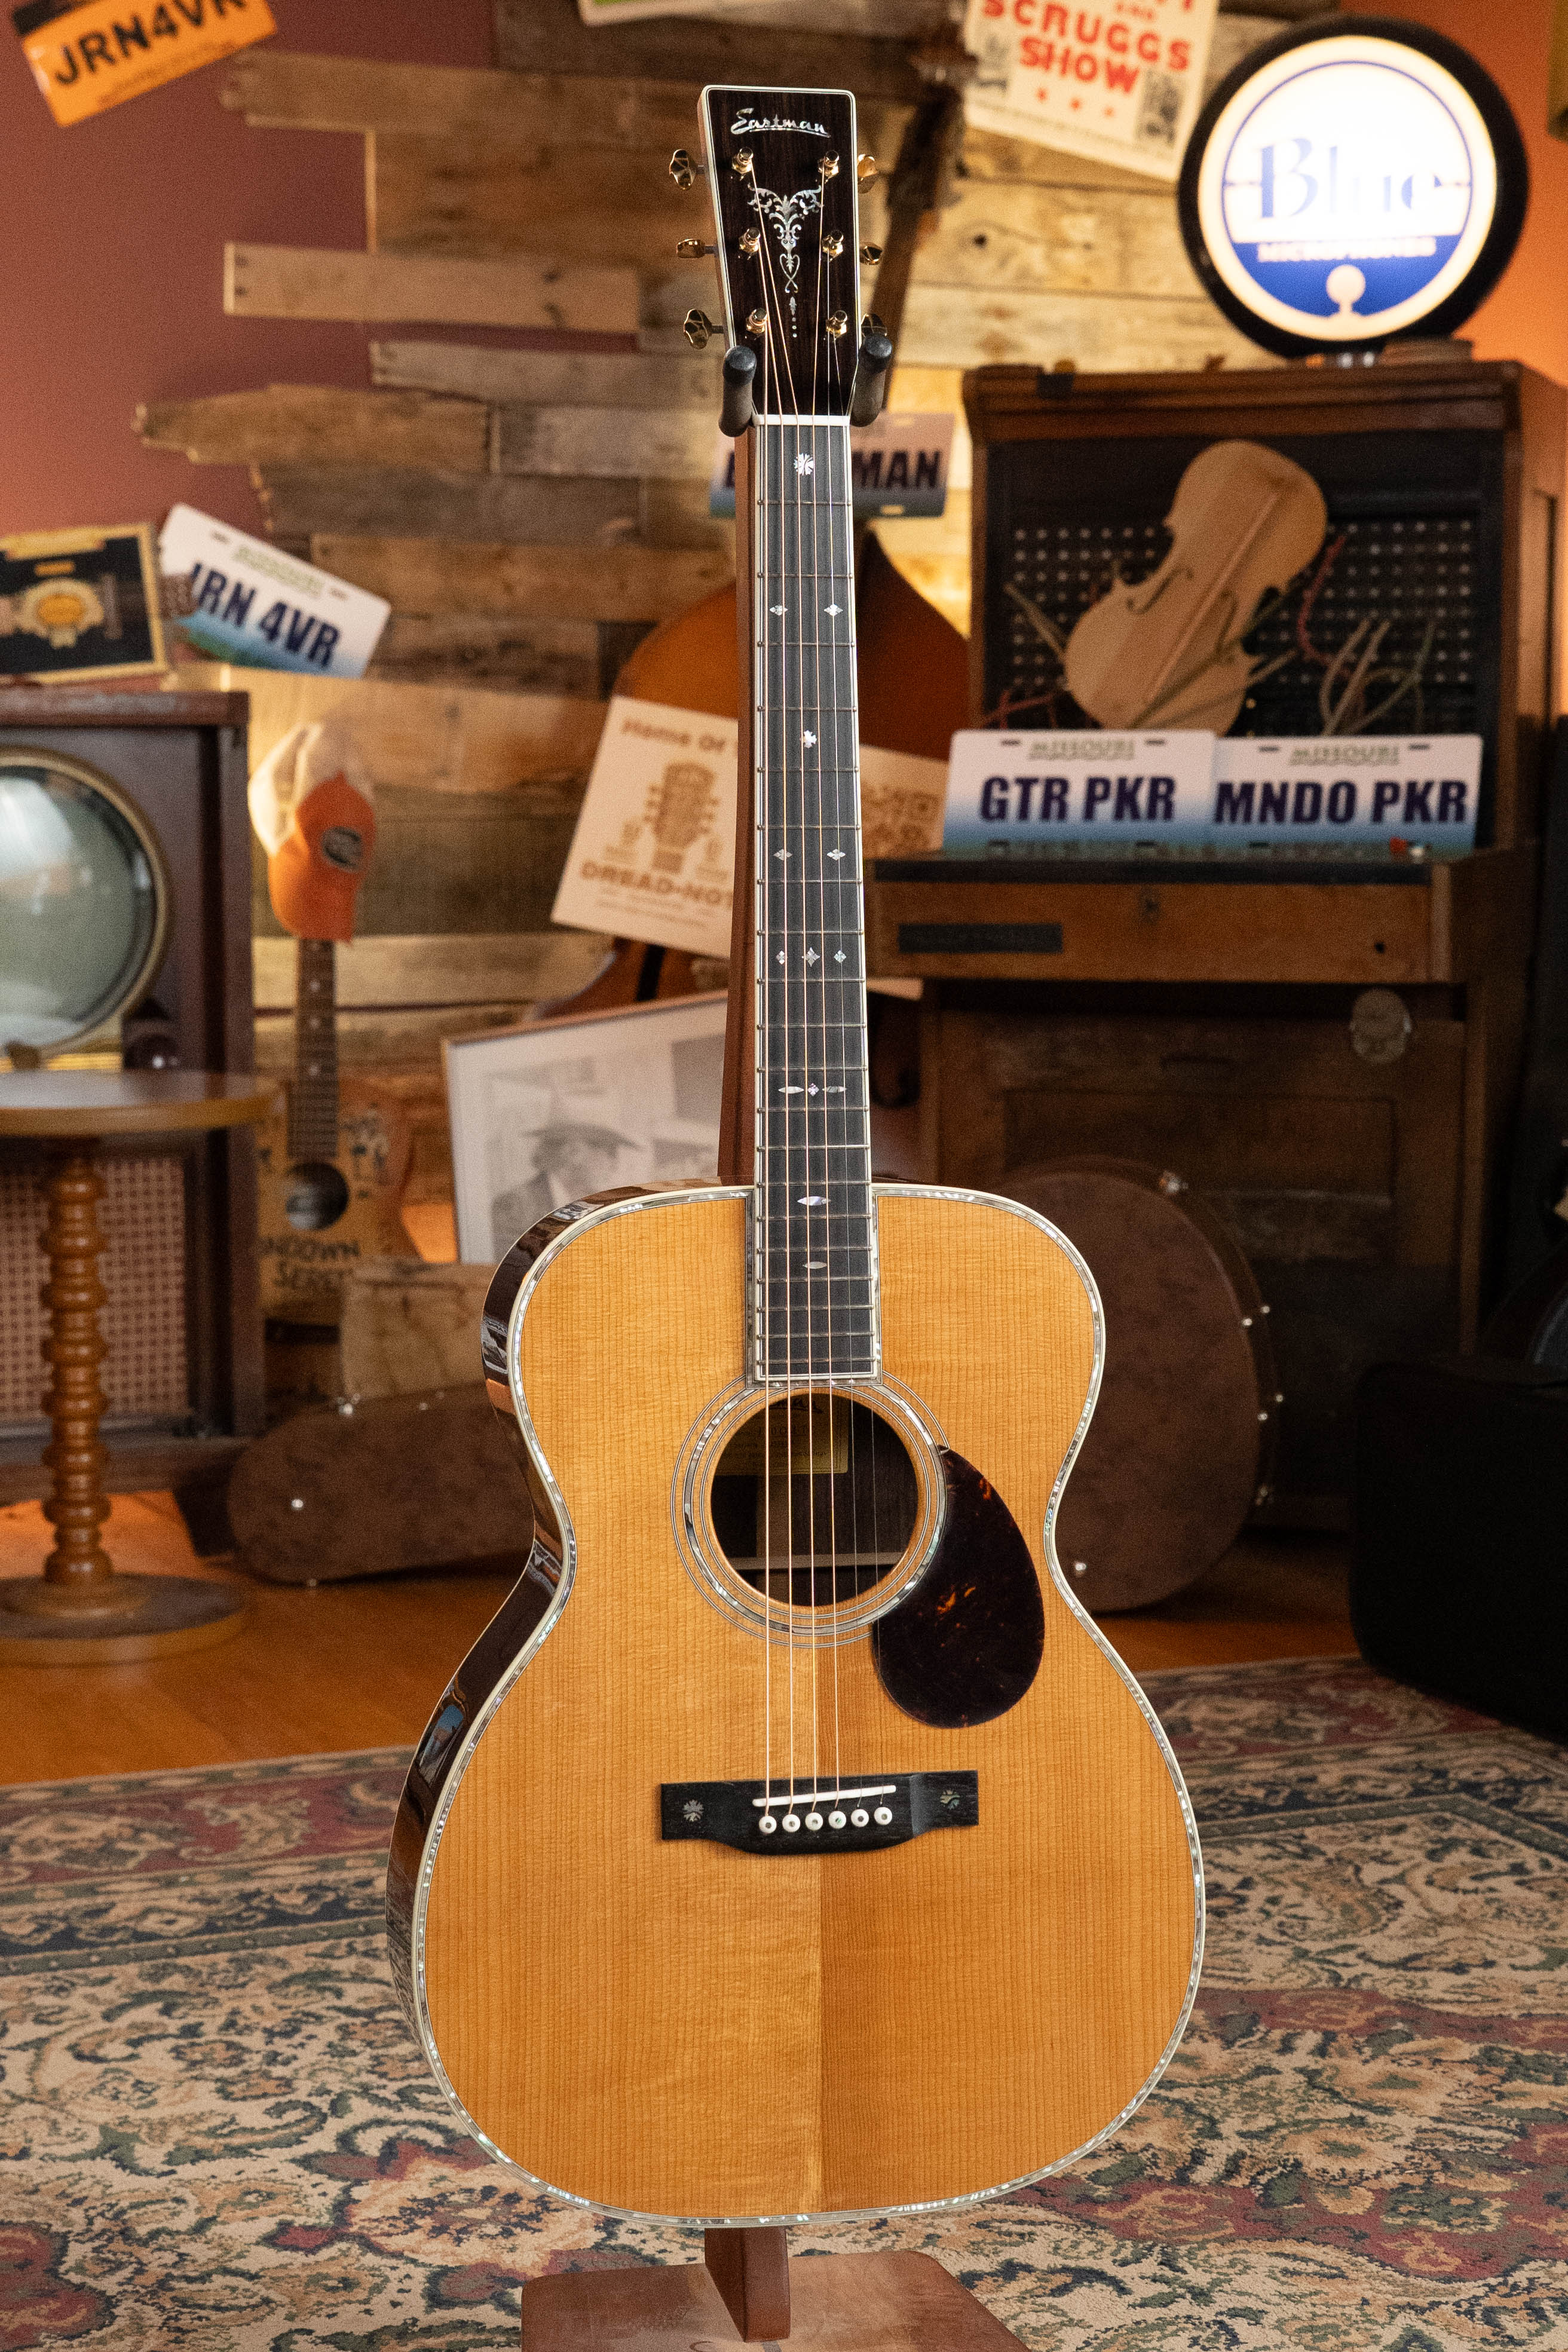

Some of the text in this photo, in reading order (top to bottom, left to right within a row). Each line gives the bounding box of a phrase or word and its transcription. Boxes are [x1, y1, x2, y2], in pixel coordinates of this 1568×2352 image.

[1019, 37, 1138, 94] SHOW
[731, 108, 831, 138] Eastman
[259, 599, 342, 668] 4VR
[980, 776, 1176, 822] GTR PKR
[1214, 780, 1468, 825] MNDO PKR
